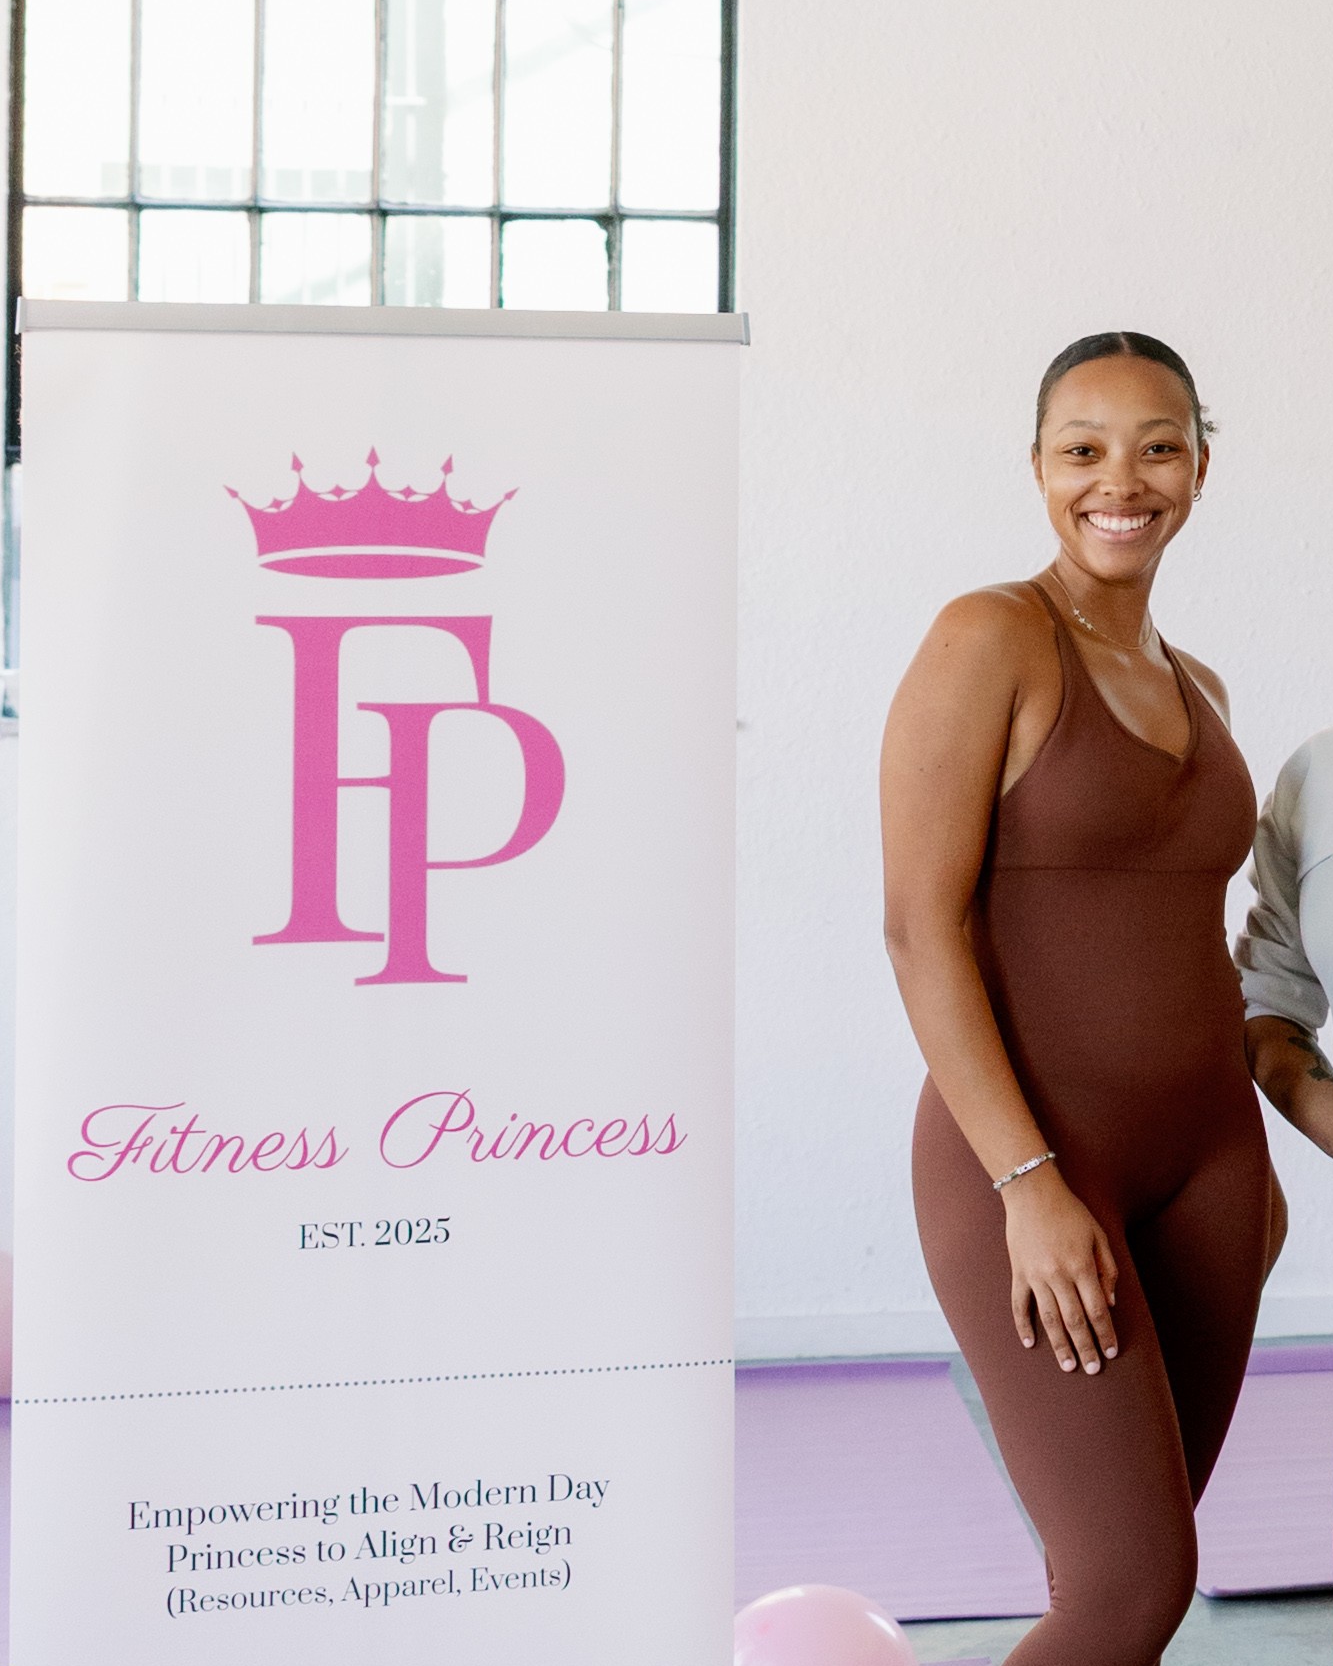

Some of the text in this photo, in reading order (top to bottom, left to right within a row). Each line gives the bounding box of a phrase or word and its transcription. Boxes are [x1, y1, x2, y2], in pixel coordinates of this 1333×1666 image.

[66, 1088, 688, 1182] Fitness Princess
[299, 1217, 452, 1250] EST. 2025
[127, 1475, 611, 1534] Empowering the Modern Day
[166, 1522, 574, 1574] Princess to Align & Reign
[166, 1559, 573, 1620] (Resources, Apparel, Events)
